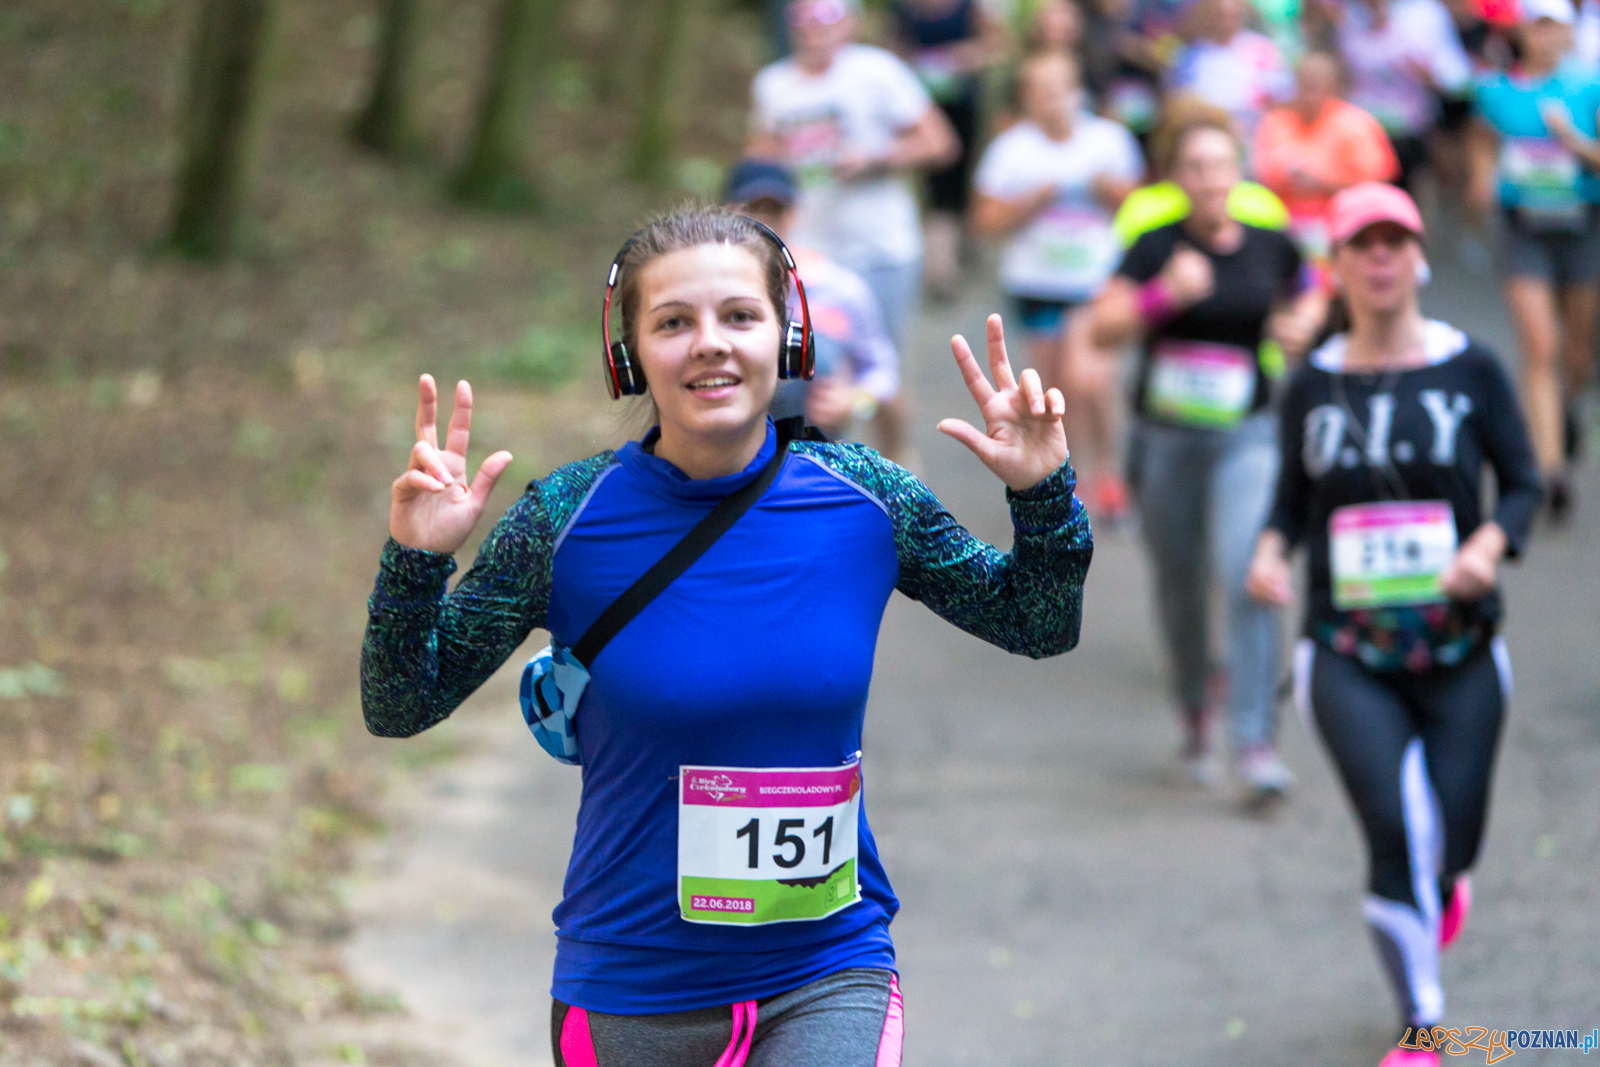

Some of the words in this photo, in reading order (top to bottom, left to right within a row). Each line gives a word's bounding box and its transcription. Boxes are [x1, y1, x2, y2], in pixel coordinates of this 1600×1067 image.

[759, 785, 842, 795] BIEGCZEKOLADOWY.PL
[736, 816, 834, 869] 151
[693, 898, 752, 911] 22.06.2018
